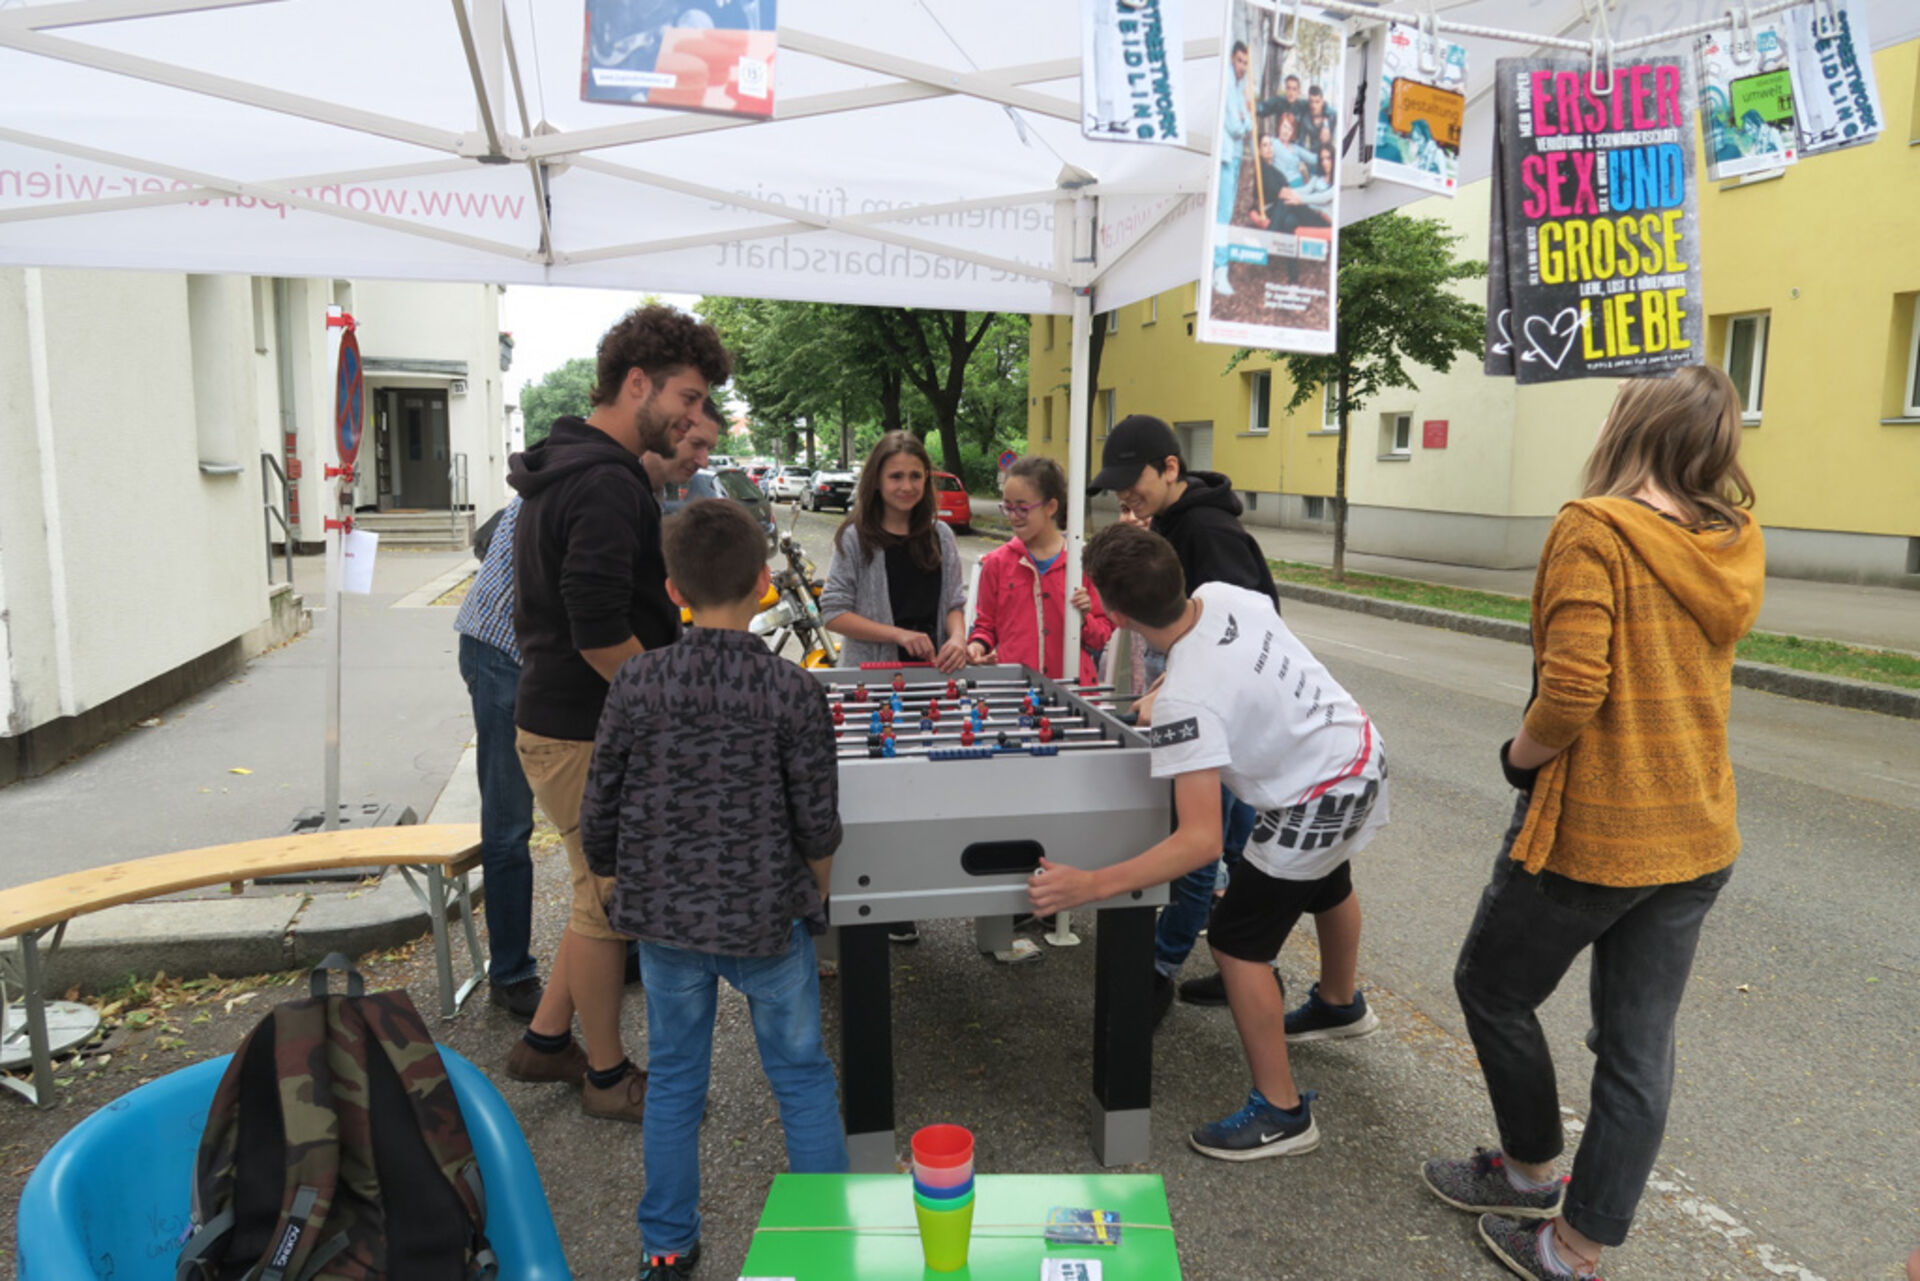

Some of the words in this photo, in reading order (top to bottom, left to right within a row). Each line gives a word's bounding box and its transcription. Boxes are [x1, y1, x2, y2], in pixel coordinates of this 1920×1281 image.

[1531, 66, 1683, 136] ERSTER
[1742, 86, 1783, 103] umwelt
[1521, 151, 1600, 219] SEX
[1608, 143, 1685, 212] UND
[1538, 210, 1688, 284] GROSSE
[1580, 288, 1692, 361] LIEBE
[277, 1226, 300, 1267] AOKING
